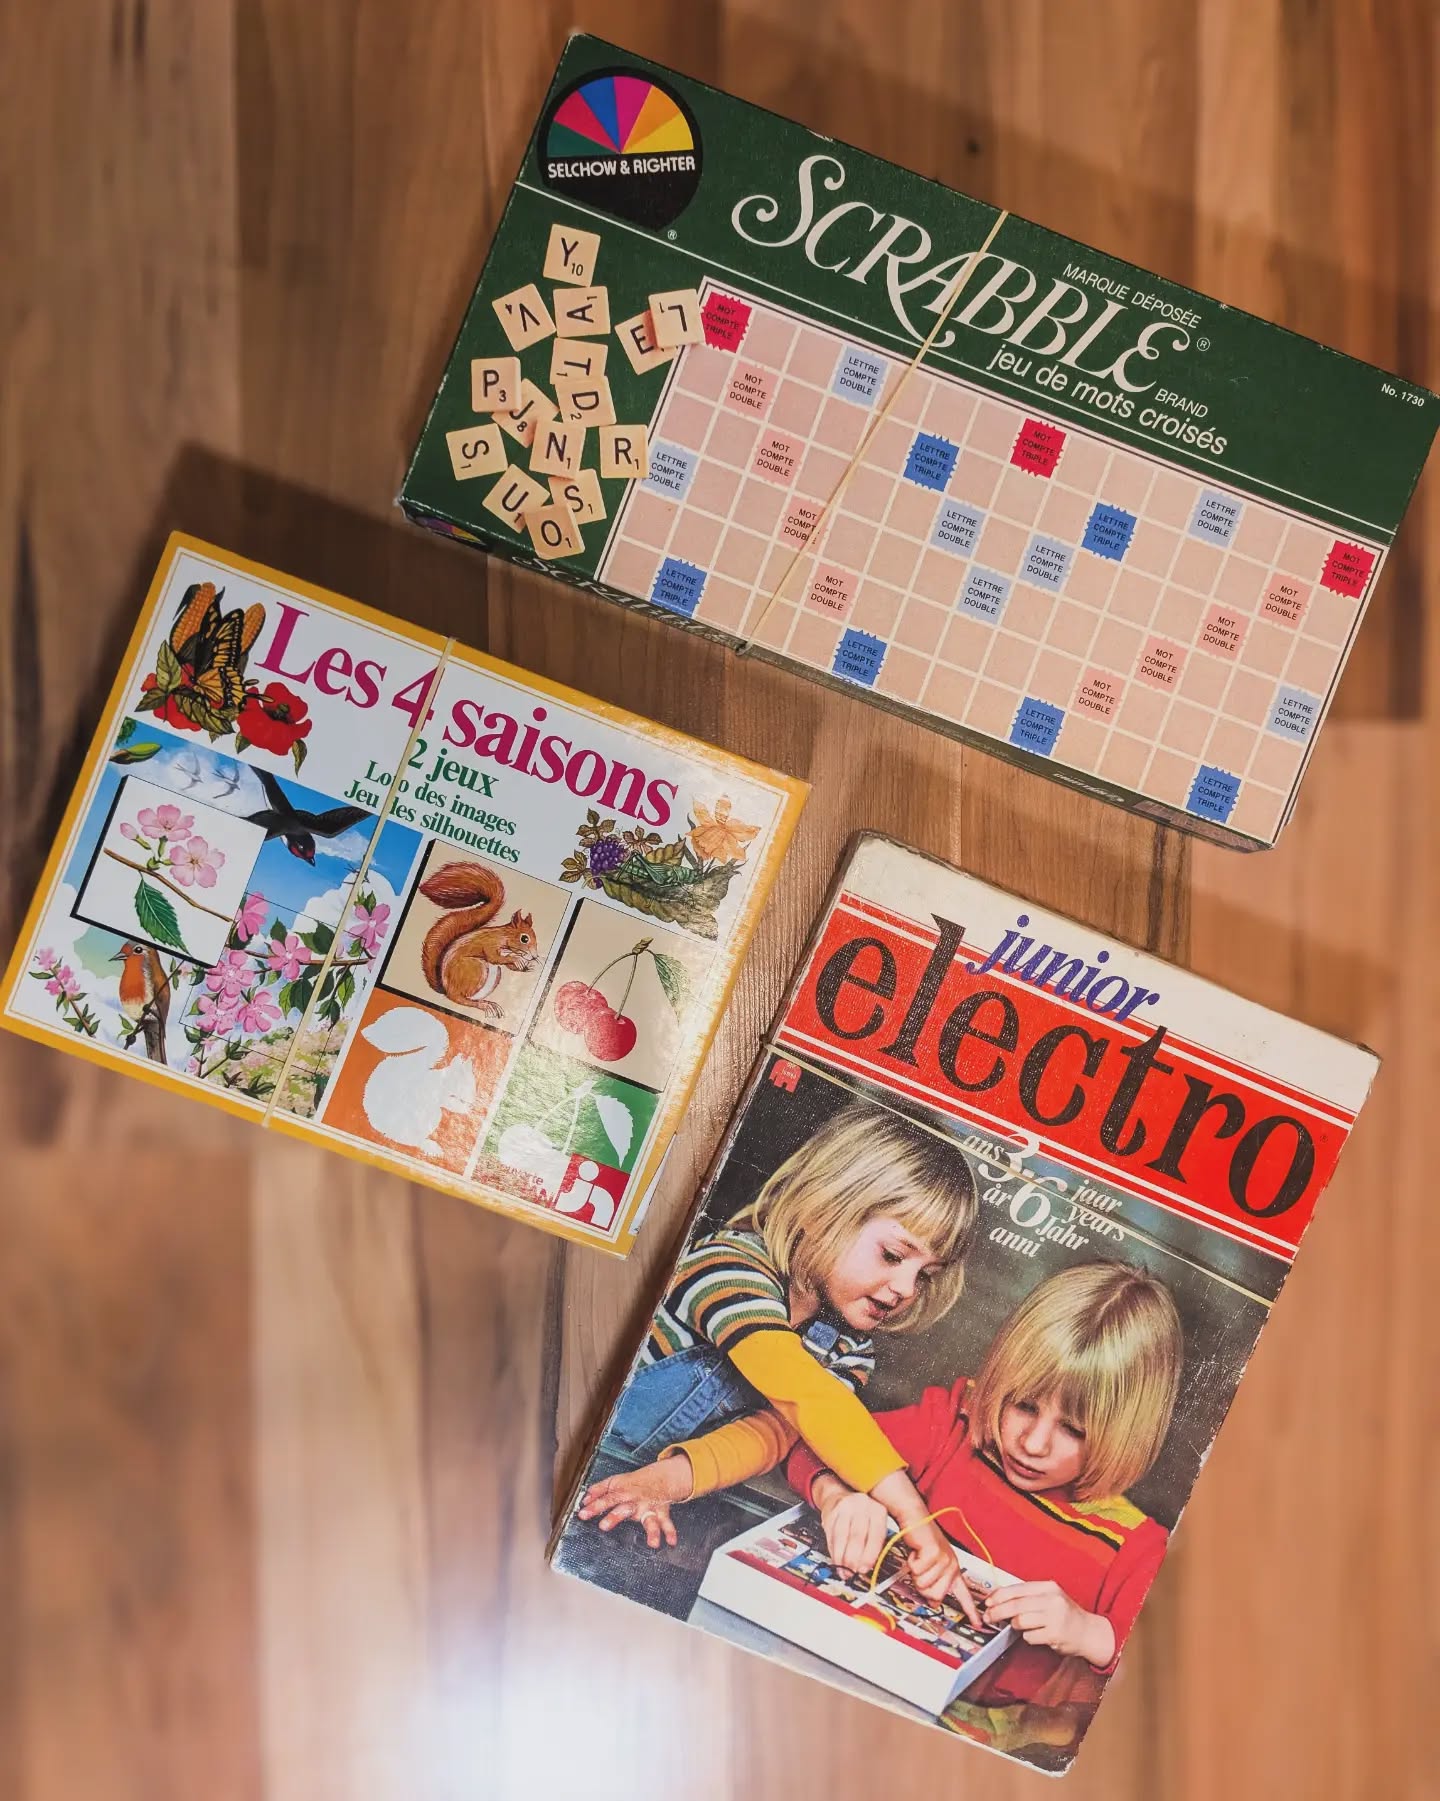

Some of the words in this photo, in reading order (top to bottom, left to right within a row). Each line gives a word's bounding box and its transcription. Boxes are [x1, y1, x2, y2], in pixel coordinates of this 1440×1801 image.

[548, 160, 617, 179] SELCHOW
[620, 161, 631, 174] &
[633, 156, 696, 174] RIGHTER
[731, 155, 1191, 393] SCRABBLE
[1062, 263, 1130, 300] MARQUE
[1131, 291, 1202, 329] DÉPOSÉE
[717, 304, 737, 316] MOT
[706, 312, 740, 330] COMPTE
[705, 324, 734, 340] TRIPLE
[848, 356, 879, 375] LETTRE
[745, 373, 763, 385] MOT
[843, 368, 877, 385] COMPTE
[733, 381, 767, 399] COMPTE
[839, 378, 872, 396] DOUBLE
[1381, 383, 1398, 398] No.
[1400, 391, 1425, 407] 1730
[730, 392, 762, 409] DOUBLE
[985, 344, 1032, 377] jeu
[1035, 366, 1068, 391] de
[1070, 379, 1136, 418] mots
[1138, 407, 1228, 455] croisés
[1154, 388, 1209, 418] BRAND
[1034, 430, 1052, 442] MOT
[772, 440, 790, 453] MOT
[920, 442, 950, 460] LETTRE
[1022, 439, 1056, 456] COMPTE
[656, 452, 687, 470] LETTRE
[760, 448, 794, 466] COMPTE
[914, 454, 948, 472] COMPTE
[1022, 450, 1049, 465] TRIPLE
[651, 463, 684, 481] COMPTE
[757, 459, 790, 476] DOUBLE
[914, 464, 942, 480] TRIPLE
[799, 508, 817, 521] MOT
[1206, 500, 1236, 517] LETTRE
[788, 516, 820, 534] COMPT
[947, 510, 977, 528] LETTRE
[1098, 512, 1129, 530] LETTRE
[1201, 510, 1234, 527] COMPTE
[941, 520, 975, 538] COMPTE
[1093, 524, 1126, 541] COMPTE
[1198, 519, 1229, 537] DOUBLE
[938, 531, 971, 548] DOUBLE
[1093, 535, 1120, 550] TRIPLE
[1036, 545, 1066, 562] LETTRE
[1343, 552, 1361, 565] MOT
[1030, 555, 1063, 573] COMPTE
[1332, 560, 1365, 578] COMPTE
[666, 568, 697, 585] LETTRE
[826, 575, 844, 588] MOT
[1026, 565, 1059, 583] DOUBLE
[661, 579, 694, 597] COMPTE
[814, 583, 848, 601] COMPTE
[973, 576, 1004, 594] LETTRE
[1280, 585, 1298, 597] MOT
[660, 590, 689, 606] TRIPLE
[810, 594, 844, 611] DOUBLE
[967, 587, 1001, 605] COMPTE
[1269, 593, 1302, 611] COMPTE
[964, 597, 996, 615] DOUBLE
[1265, 604, 1297, 621] DOUBLE
[1218, 616, 1235, 628] MOT
[1207, 624, 1240, 642] COMPTE
[848, 640, 878, 657] LETTRE
[1203, 634, 1235, 652] DOUBLE
[842, 650, 875, 667] COMPTE
[1156, 648, 1174, 660] MOT
[841, 662, 869, 677] TRIPLE
[1144, 656, 1177, 674] COMPTE
[1141, 666, 1173, 683] DOUBLE
[1093, 679, 1111, 692] MOT
[1082, 687, 1115, 705] COMPTE
[254, 601, 387, 709] Les
[391, 666, 441, 731] 4
[442, 699, 679, 827] saisons
[1078, 697, 1110, 715] DOUBLE
[1283, 698, 1313, 714] LETTRE
[1026, 709, 1056, 725] LETTRE
[1278, 708, 1310, 725] COMPTE
[1020, 719, 1054, 735] COMPTE
[1274, 718, 1306, 734] DOUBLE
[1020, 729, 1047, 745] TRIPLE
[407, 738, 428, 770] 2
[425, 748, 499, 799] jeux
[1203, 776, 1233, 792] LETTRE
[364, 760, 410, 794] Loo
[414, 782, 447, 808] des
[451, 794, 517, 837] images
[1198, 787, 1230, 804] COMPTE
[1197, 798, 1225, 813] TRIPLE
[343, 779, 378, 809] Jeu
[419, 812, 521, 864] silhouettes
[966, 914, 1160, 1022] junior
[815, 912, 1316, 1219] electro
[963, 1135, 1004, 1161] ans
[982, 1183, 1012, 1208] år
[1069, 1179, 1123, 1213] jaar
[1061, 1204, 1125, 1242] years
[989, 1226, 1046, 1258] anni
